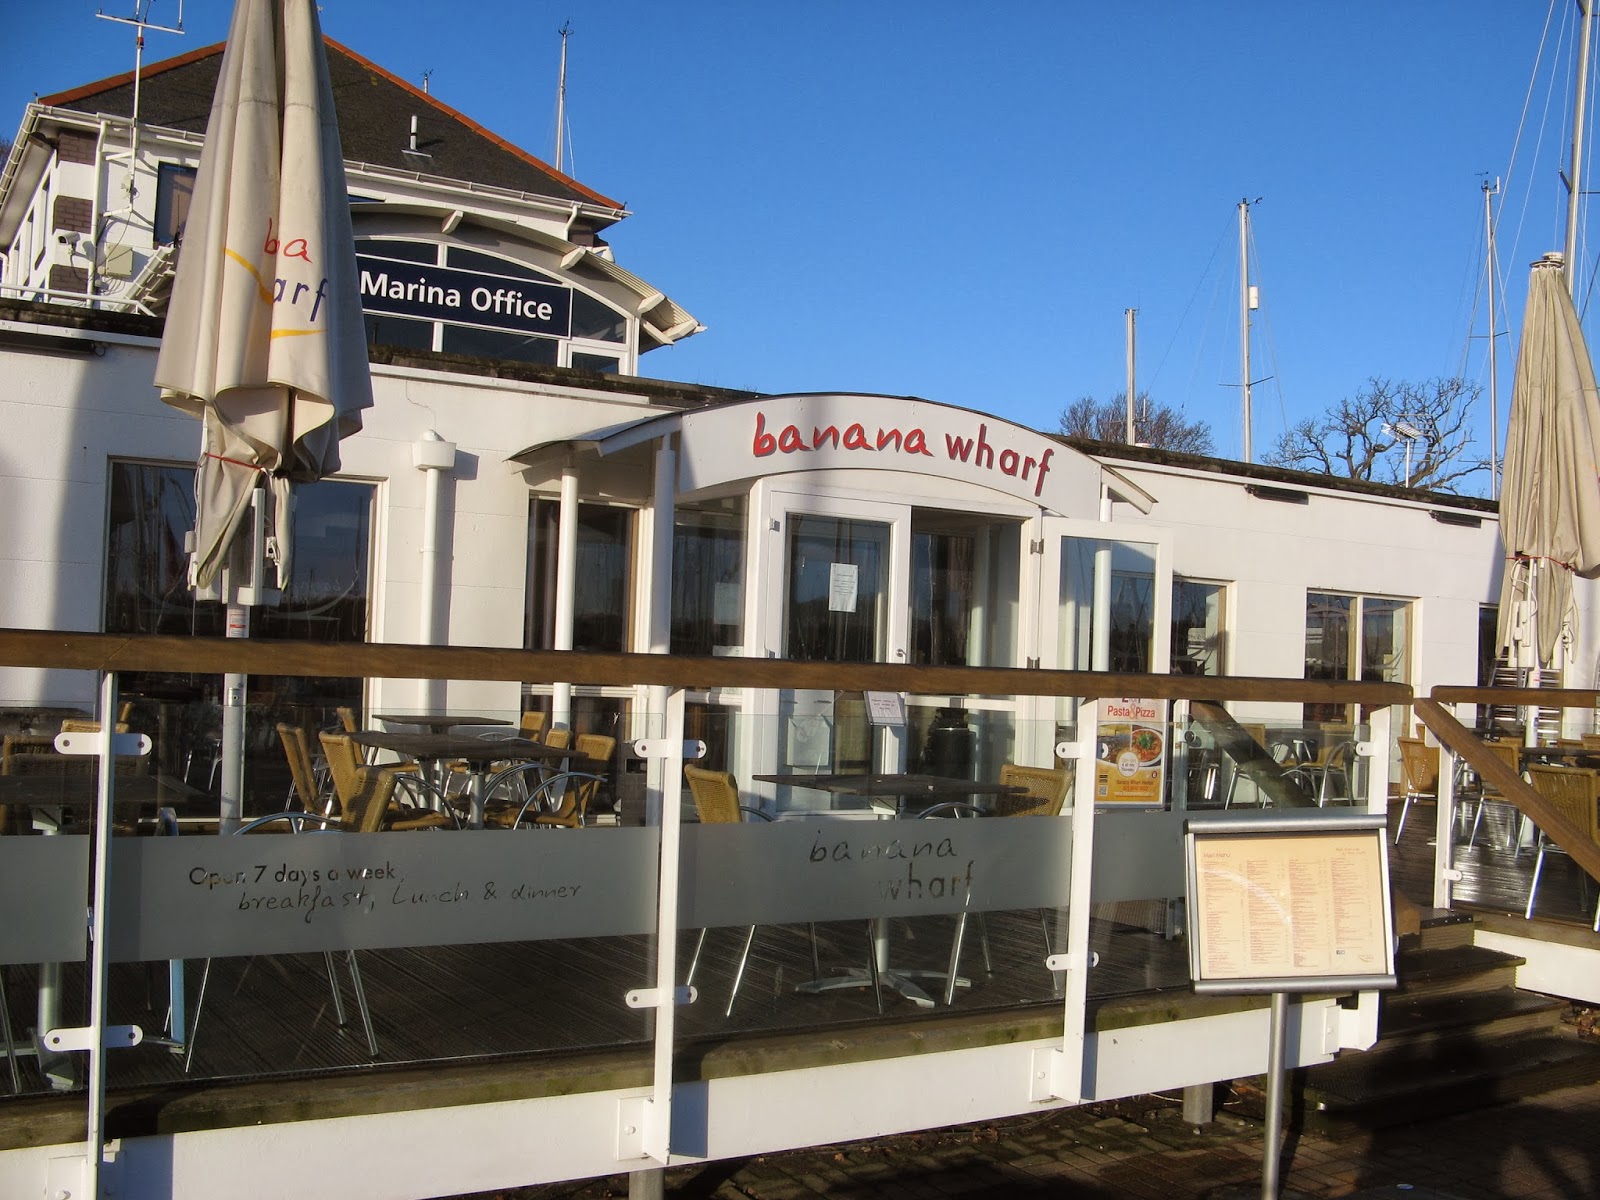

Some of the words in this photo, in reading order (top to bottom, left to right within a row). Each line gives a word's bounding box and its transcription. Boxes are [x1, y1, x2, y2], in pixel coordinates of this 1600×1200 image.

[360, 270, 461, 308] Marina
[471, 286, 553, 321] Office
[753, 411, 935, 459] banana
[945, 423, 1055, 497] wharf
[1107, 705, 1130, 717] Pasta
[1135, 706, 1156, 718] Pizza
[809, 829, 958, 863] banana
[189, 866, 246, 890] Open
[254, 865, 268, 883] 7
[274, 863, 321, 887] days
[483, 881, 498, 900] &
[511, 883, 582, 900] dinner
[875, 859, 975, 906] wharf
